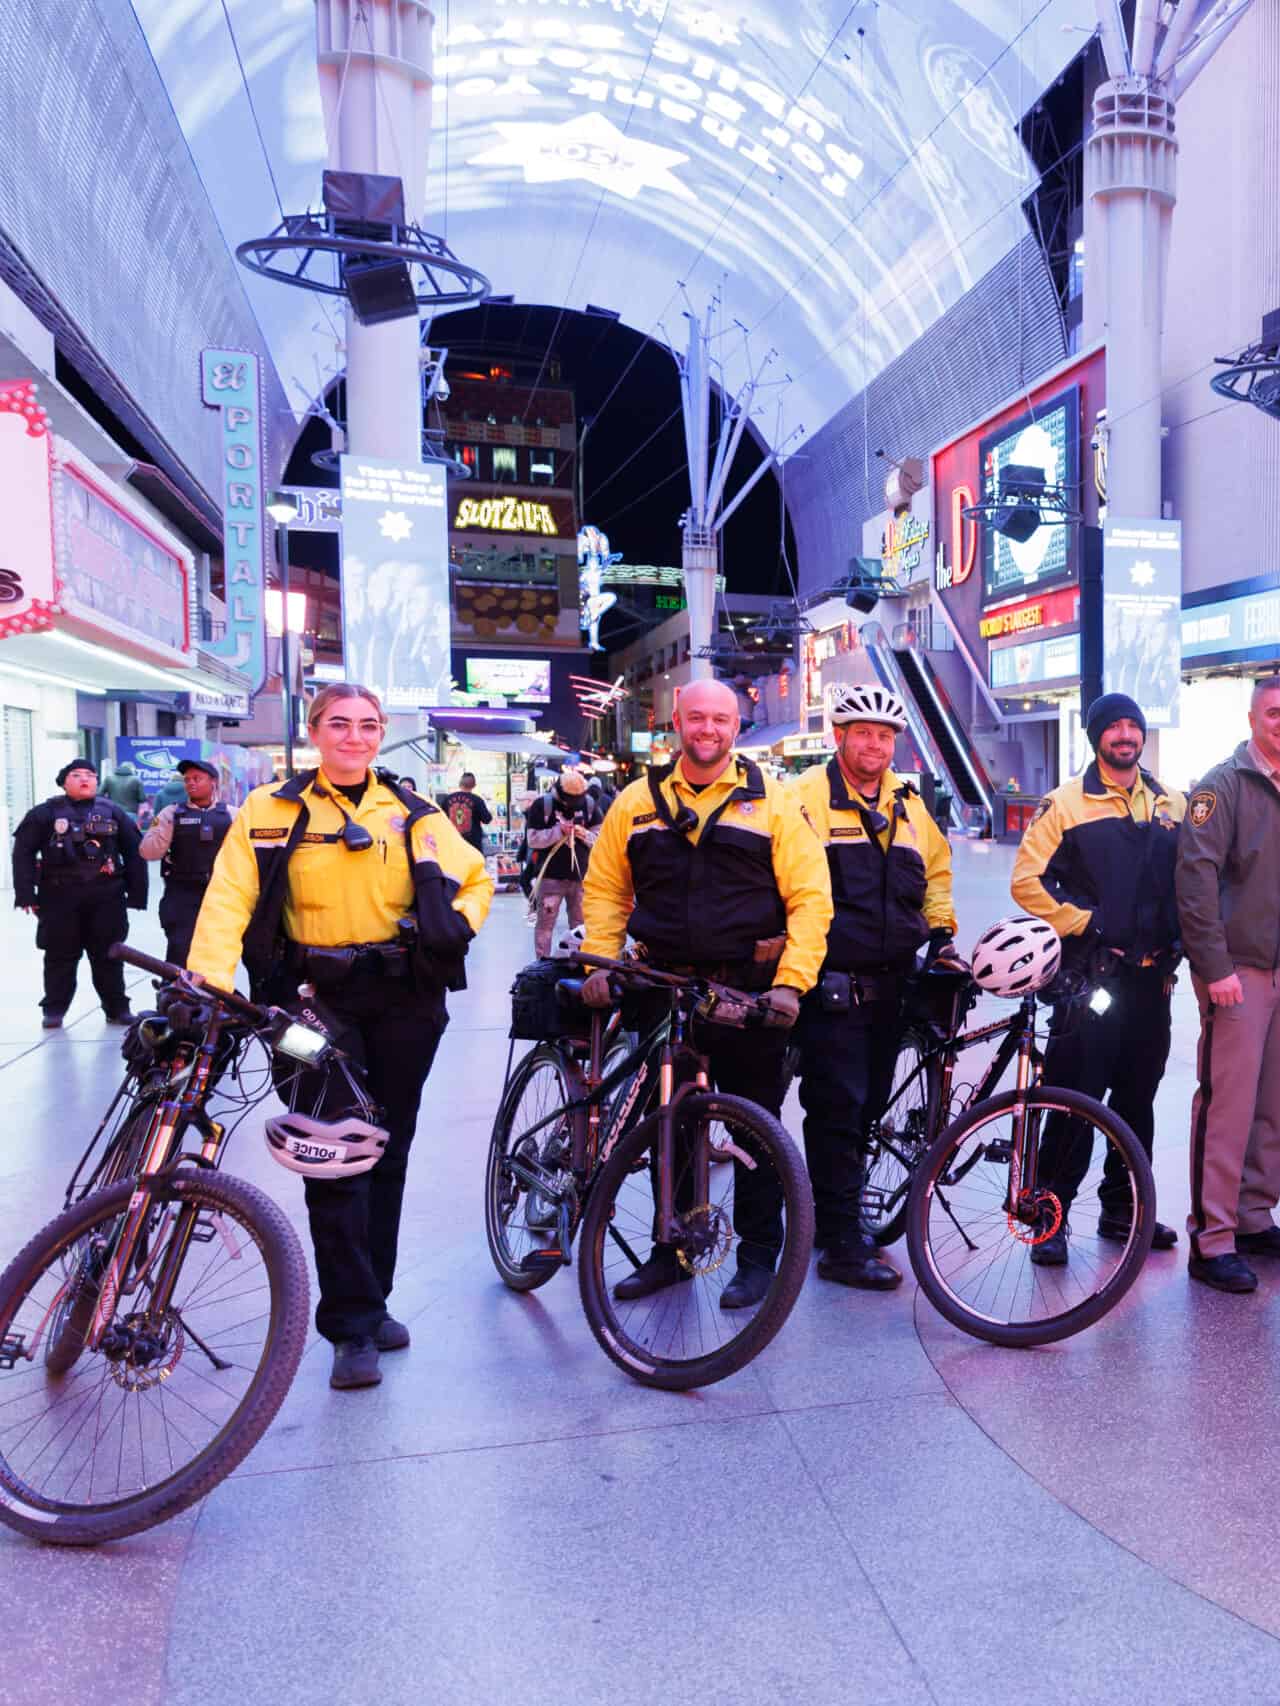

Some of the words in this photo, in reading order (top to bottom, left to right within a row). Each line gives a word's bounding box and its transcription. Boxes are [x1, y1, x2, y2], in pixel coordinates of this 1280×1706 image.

[568, 76, 778, 174] Thank
[211, 361, 248, 391] El
[225, 406, 256, 622] PORTAL
[936, 542, 953, 591] the
[952, 485, 977, 584] D
[293, 1141, 337, 1160] POLICE
